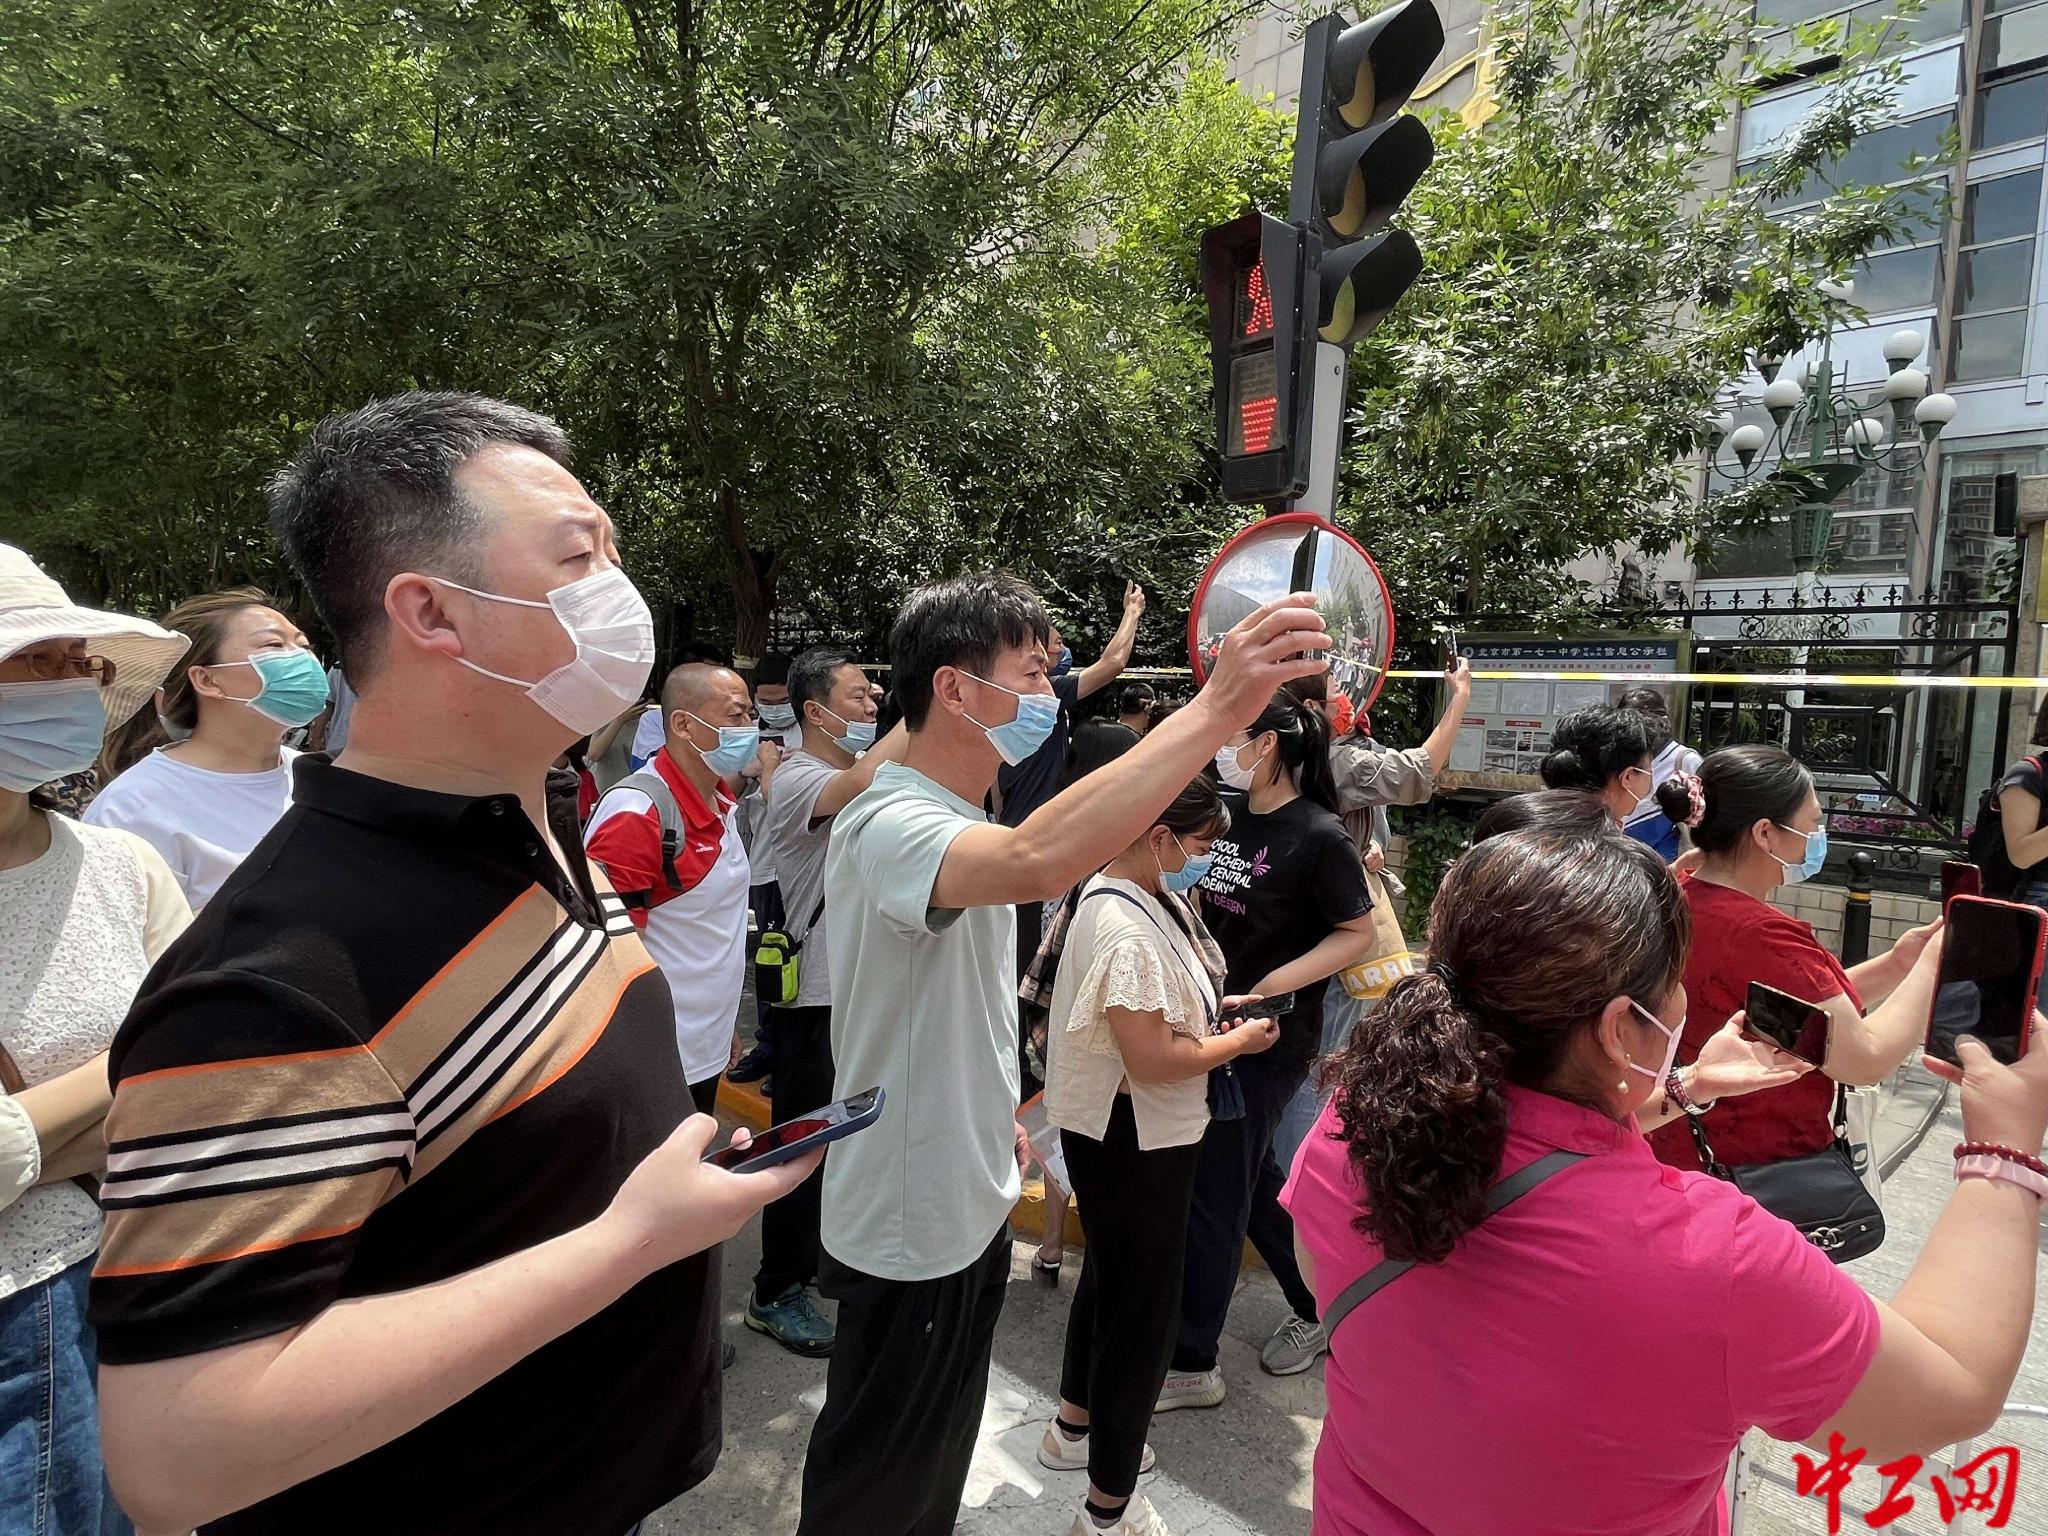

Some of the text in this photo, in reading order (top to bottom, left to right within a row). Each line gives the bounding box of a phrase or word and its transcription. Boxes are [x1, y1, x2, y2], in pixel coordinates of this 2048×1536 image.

[1211, 839, 1240, 857] CHOOL
[1209, 851, 1245, 872] TACHED
[1199, 876, 1229, 894] ADEMY
[1211, 866, 1251, 888] CENTRAL
